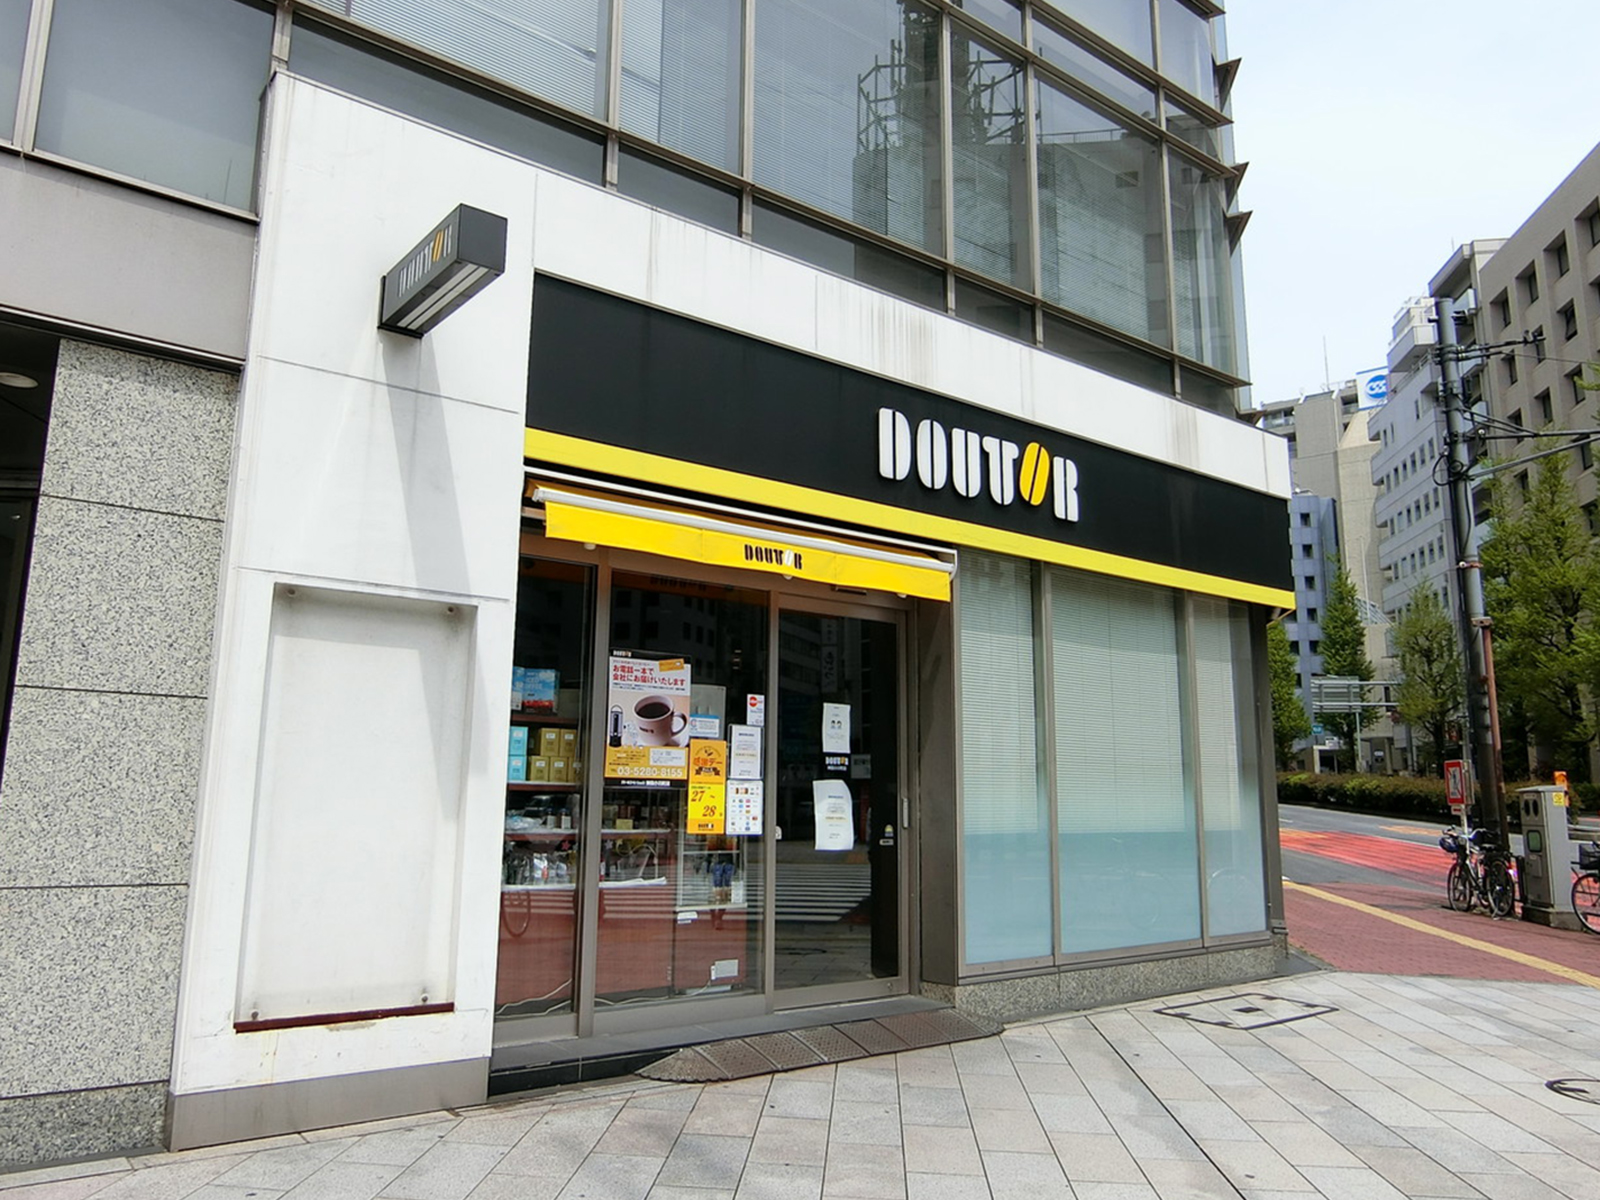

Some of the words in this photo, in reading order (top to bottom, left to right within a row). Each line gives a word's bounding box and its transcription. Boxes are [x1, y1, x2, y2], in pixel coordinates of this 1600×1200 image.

[398, 223, 453, 298] DOUTOR
[878, 407, 1080, 523] DOUTOR
[744, 543, 803, 571] DOUTOR
[612, 664, 655, 676] お電話一本で
[612, 672, 686, 687] 会社にお届けいたします
[690, 790, 706, 802] 27
[702, 804, 717, 818] 28
